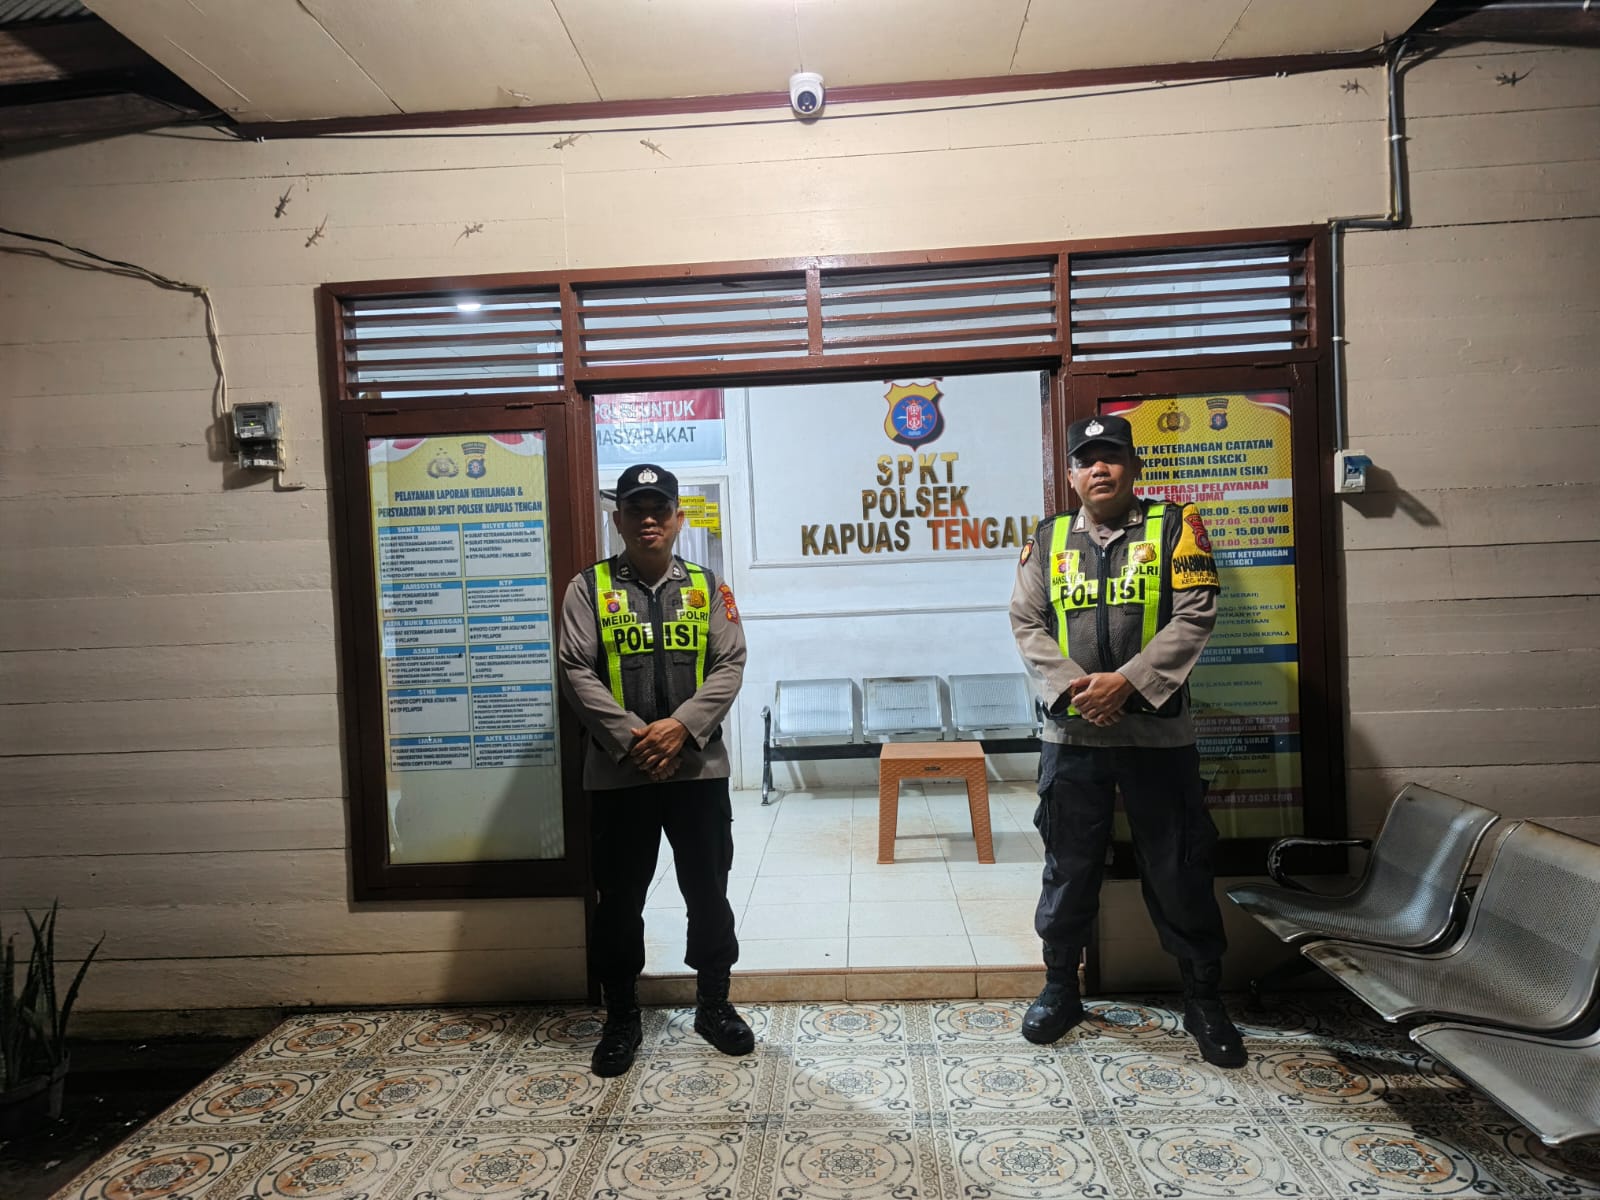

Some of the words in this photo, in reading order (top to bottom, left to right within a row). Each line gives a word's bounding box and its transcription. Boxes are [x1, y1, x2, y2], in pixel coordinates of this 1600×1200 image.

[640, 399, 695, 418] UNTUK
[1152, 442, 1222, 455] KETERANGAN
[1225, 439, 1273, 450] CATATAN
[876, 452, 959, 486] SPKT
[1142, 456, 1205, 468] KEPOLISIAN
[1172, 467, 1238, 480] KERAMAIAN
[395, 489, 435, 501] PELAYANAN
[436, 488, 469, 500] LAPORAN
[471, 486, 515, 498] KEHILANGAN
[1148, 484, 1199, 496] OPERASI
[1201, 480, 1269, 492] PELAYANAN
[377, 506, 426, 518] PERSYARATAN
[428, 505, 436, 516] DI
[457, 503, 484, 515] POLSEK
[485, 502, 513, 513] KAPUAS
[861, 486, 969, 520] POLSEK
[1238, 505, 1265, 515] 15.00
[1267, 504, 1289, 513] WIB
[801, 520, 911, 556] KAPUAS
[927, 515, 1039, 551] TENGAH
[1235, 526, 1264, 536] 15.00
[1267, 525, 1290, 534] WIB
[1238, 549, 1289, 558] KETERANGAN
[602, 613, 635, 627] MEIDI
[679, 611, 708, 621] POLRI
